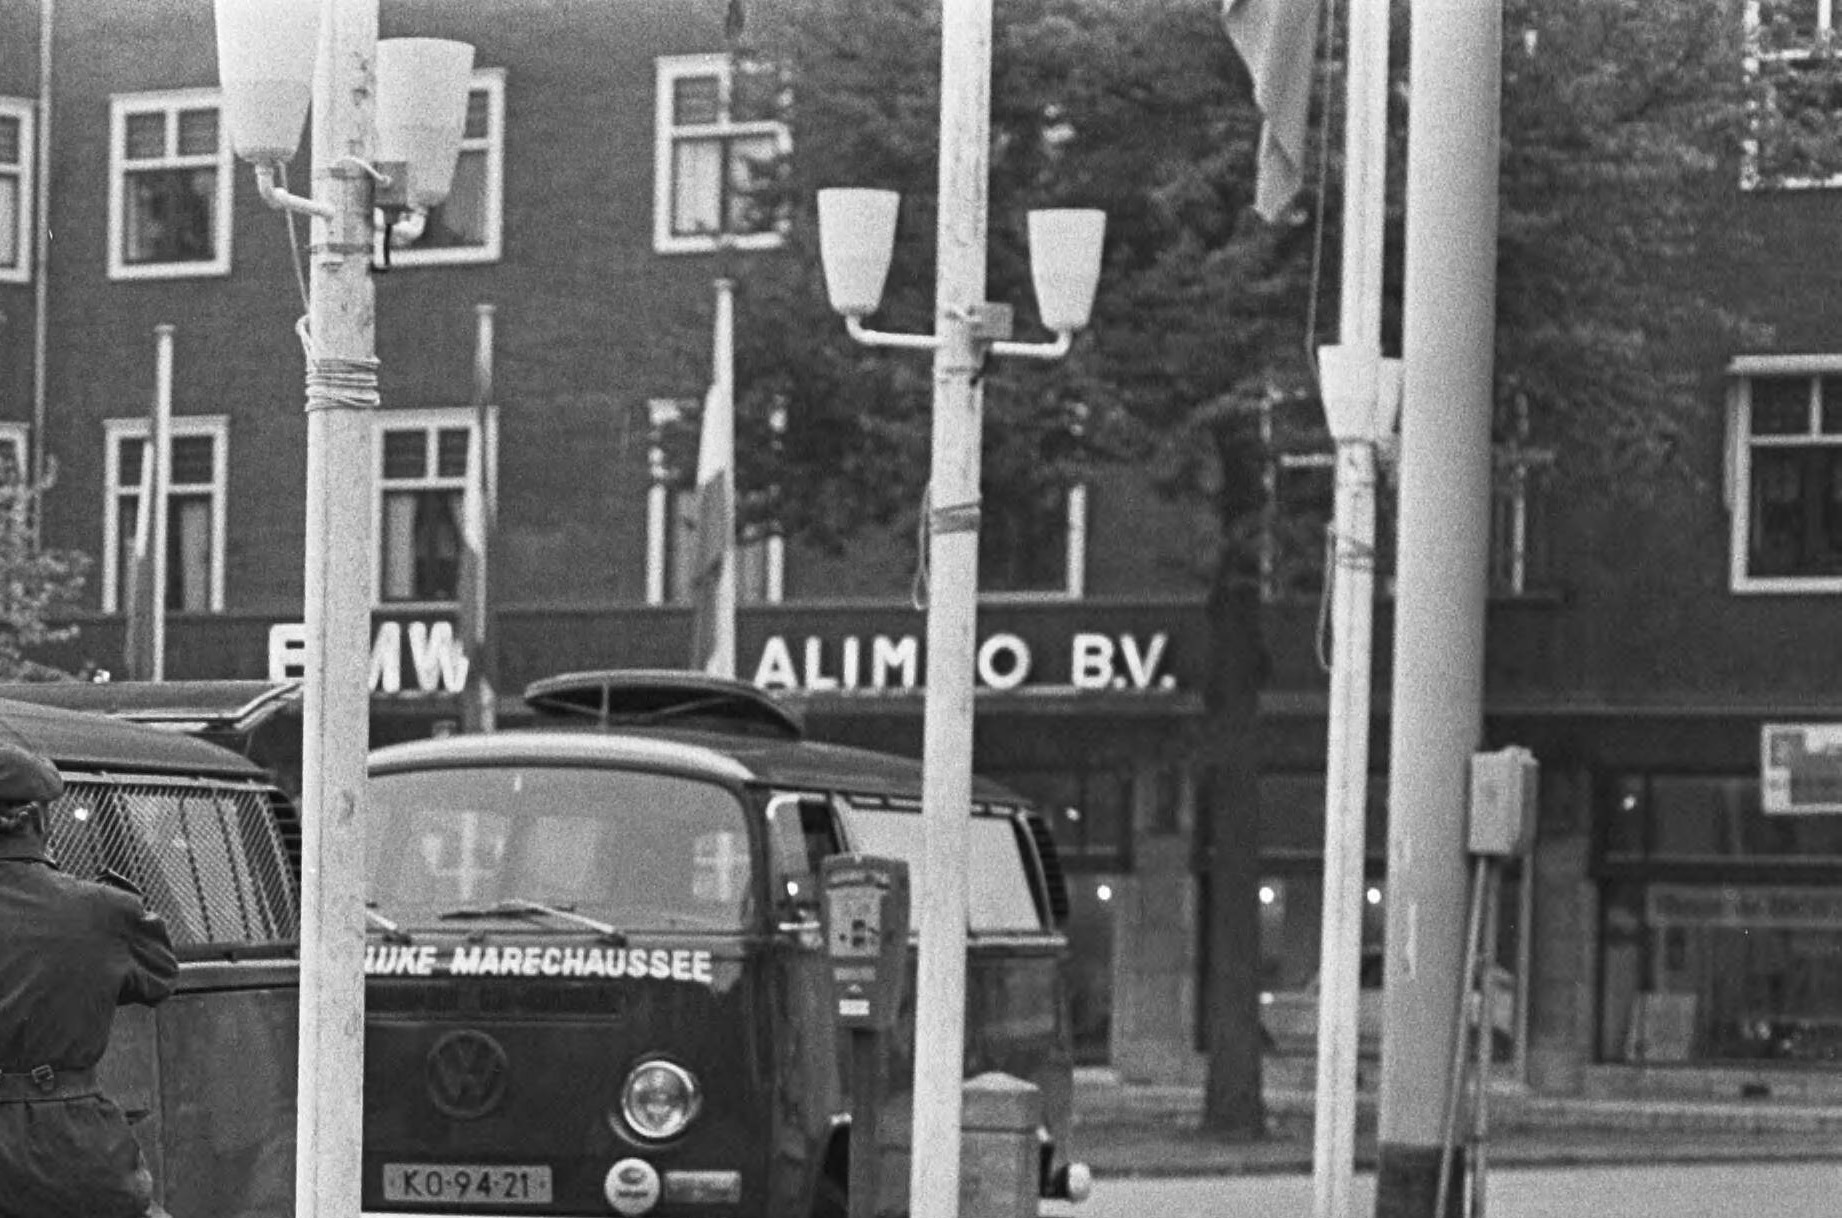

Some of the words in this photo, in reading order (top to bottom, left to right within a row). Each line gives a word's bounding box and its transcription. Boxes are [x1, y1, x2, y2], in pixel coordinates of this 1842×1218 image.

[753, 634, 1031, 690] ALIMO
[1071, 632, 1177, 689] B.V.
[364, 945, 439, 975] LIJKE
[449, 945, 714, 984] MARECHAUSSEE
